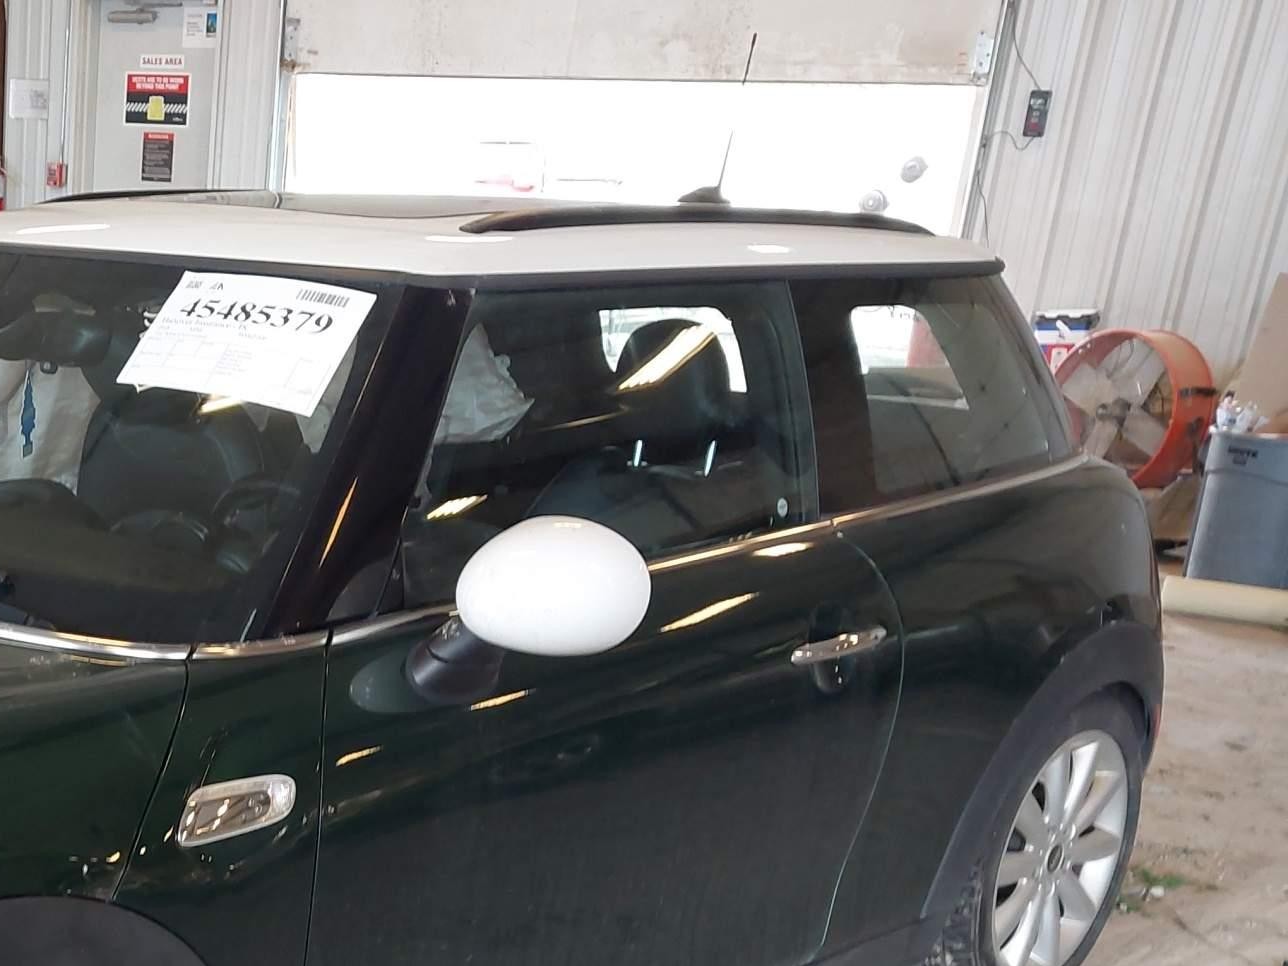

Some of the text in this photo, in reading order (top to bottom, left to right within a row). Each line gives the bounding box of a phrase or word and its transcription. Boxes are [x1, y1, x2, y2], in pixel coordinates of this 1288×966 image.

[142, 57, 183, 65] SALES AREA
[180, 298, 333, 334] 45485379
